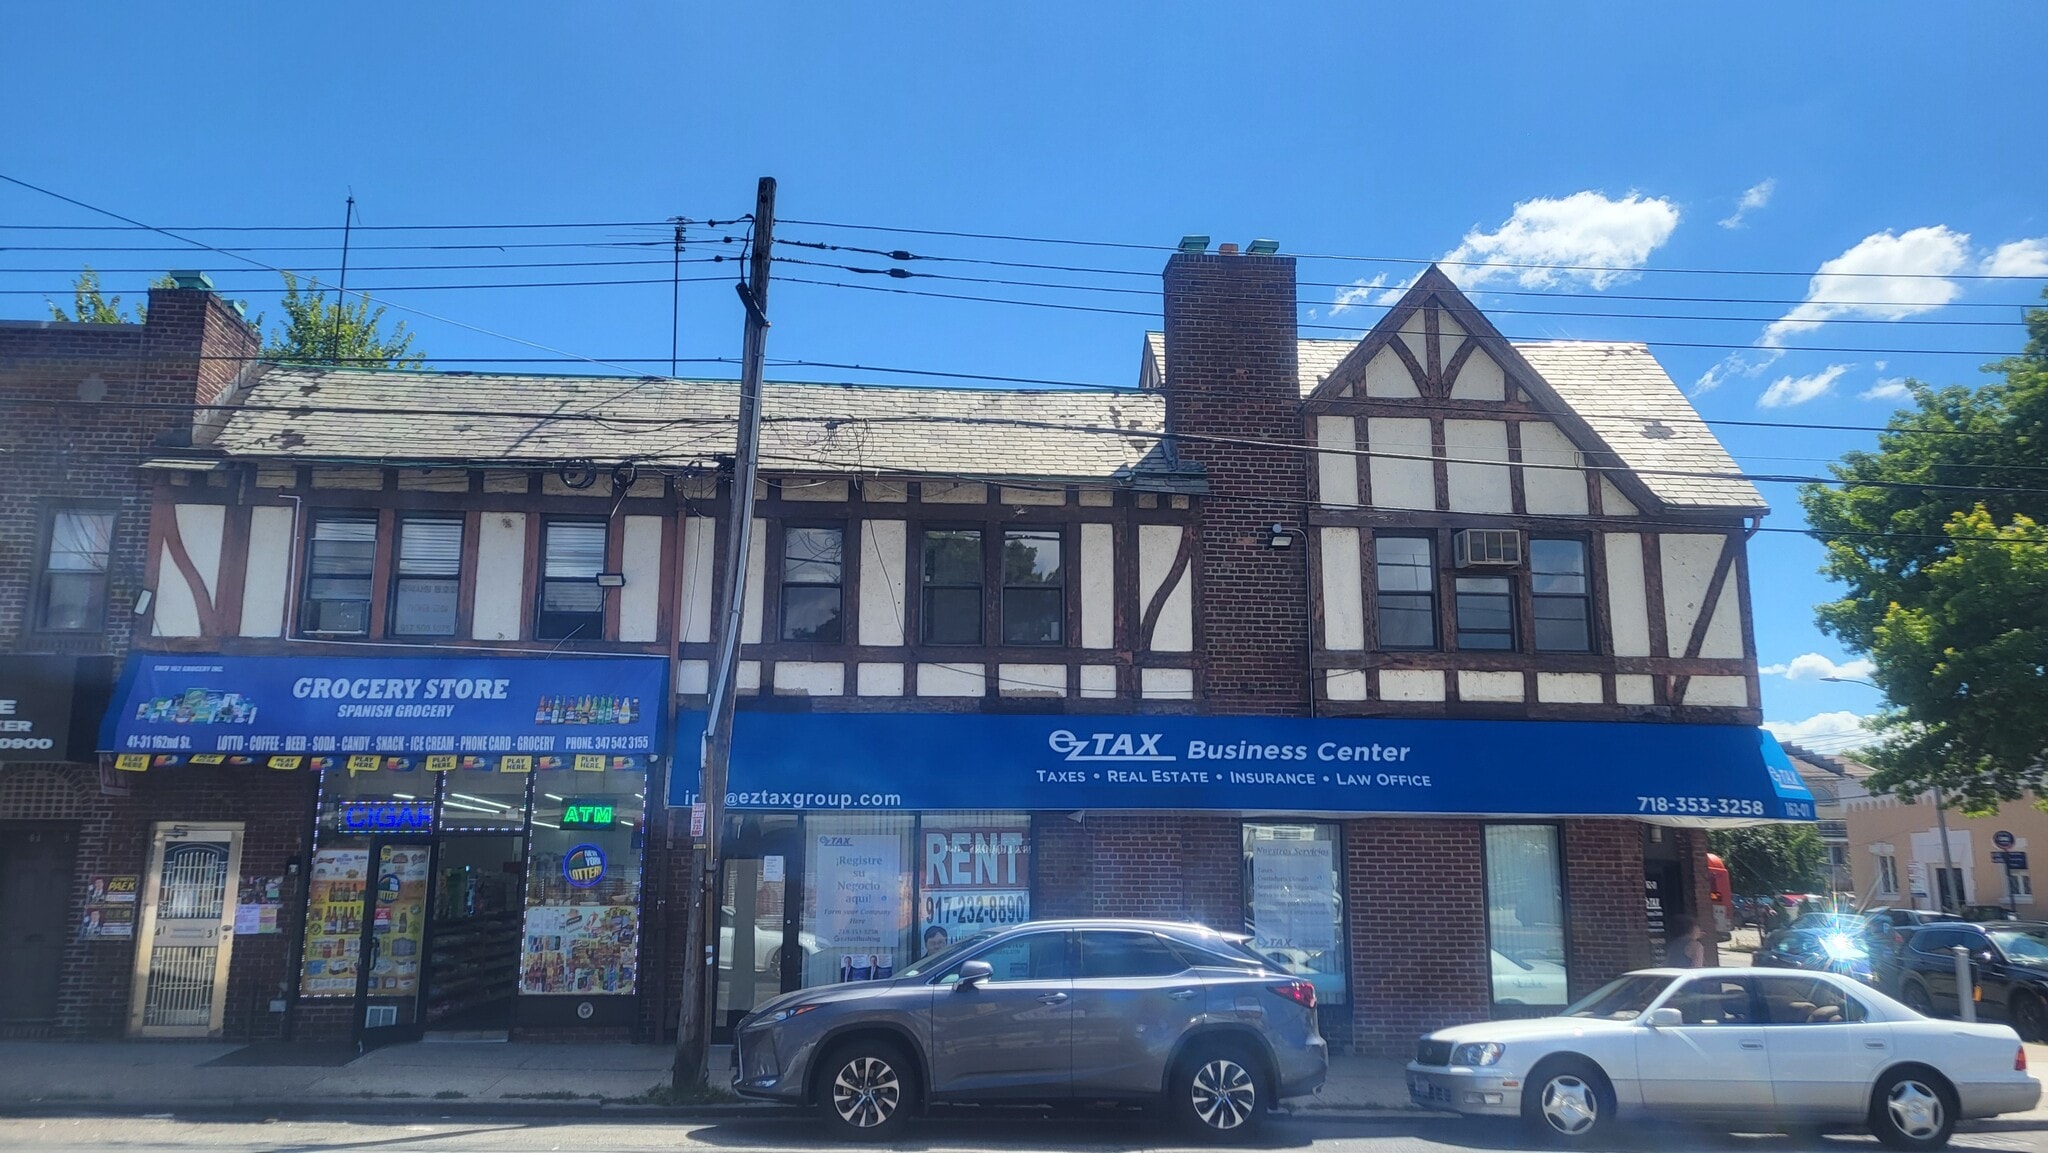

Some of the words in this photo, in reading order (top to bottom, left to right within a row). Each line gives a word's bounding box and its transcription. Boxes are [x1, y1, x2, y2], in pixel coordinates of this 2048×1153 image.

[292, 677, 421, 700] GROCERY
[424, 678, 510, 700] STORE
[337, 704, 395, 718] SPANISH
[395, 704, 454, 718] GROCERY
[126, 736, 152, 748] 41-31
[152, 736, 178, 748] 162nd
[217, 736, 244, 750] LOTTO
[250, 736, 279, 750] COFFEE
[285, 736, 306, 750] BEER
[312, 736, 336, 750] SODA
[342, 736, 370, 750] CANDY
[376, 736, 405, 750] SNACK
[410, 736, 424, 750] ICE
[426, 736, 454, 750] CREAM
[460, 736, 488, 750] PHONE
[489, 736, 511, 750] CARD
[517, 736, 555, 750] GROCERY
[595, 736, 610, 749] 347
[611, 736, 627, 749] 542
[628, 736, 648, 749] 3155
[1188, 741, 1307, 761] Business
[1317, 742, 1410, 762] Center
[1036, 770, 1086, 783] TAXES
[1107, 770, 1148, 783] REAL
[1152, 770, 1209, 783] ESTATE
[1230, 771, 1316, 785] INSURANCE
[1336, 773, 1370, 786] LAW
[1376, 773, 1432, 787] OFFICE
[1637, 797, 1764, 815] 718-353-3258
[1784, 802, 1810, 817] 162-01
[564, 806, 612, 822] ATM
[926, 832, 1022, 884] RENT
[1257, 847, 1291, 856] Nuestros
[1294, 848, 1329, 857] Servicios
[585, 857, 601, 866] YORK
[836, 856, 882, 868] ¡Registre
[853, 870, 865, 878] su
[108, 881, 135, 891] PAEK
[838, 882, 880, 893] Negocio
[926, 896, 1024, 924] 917-232-8890
[155, 926, 166, 936] 41
[207, 927, 218, 938] 31
